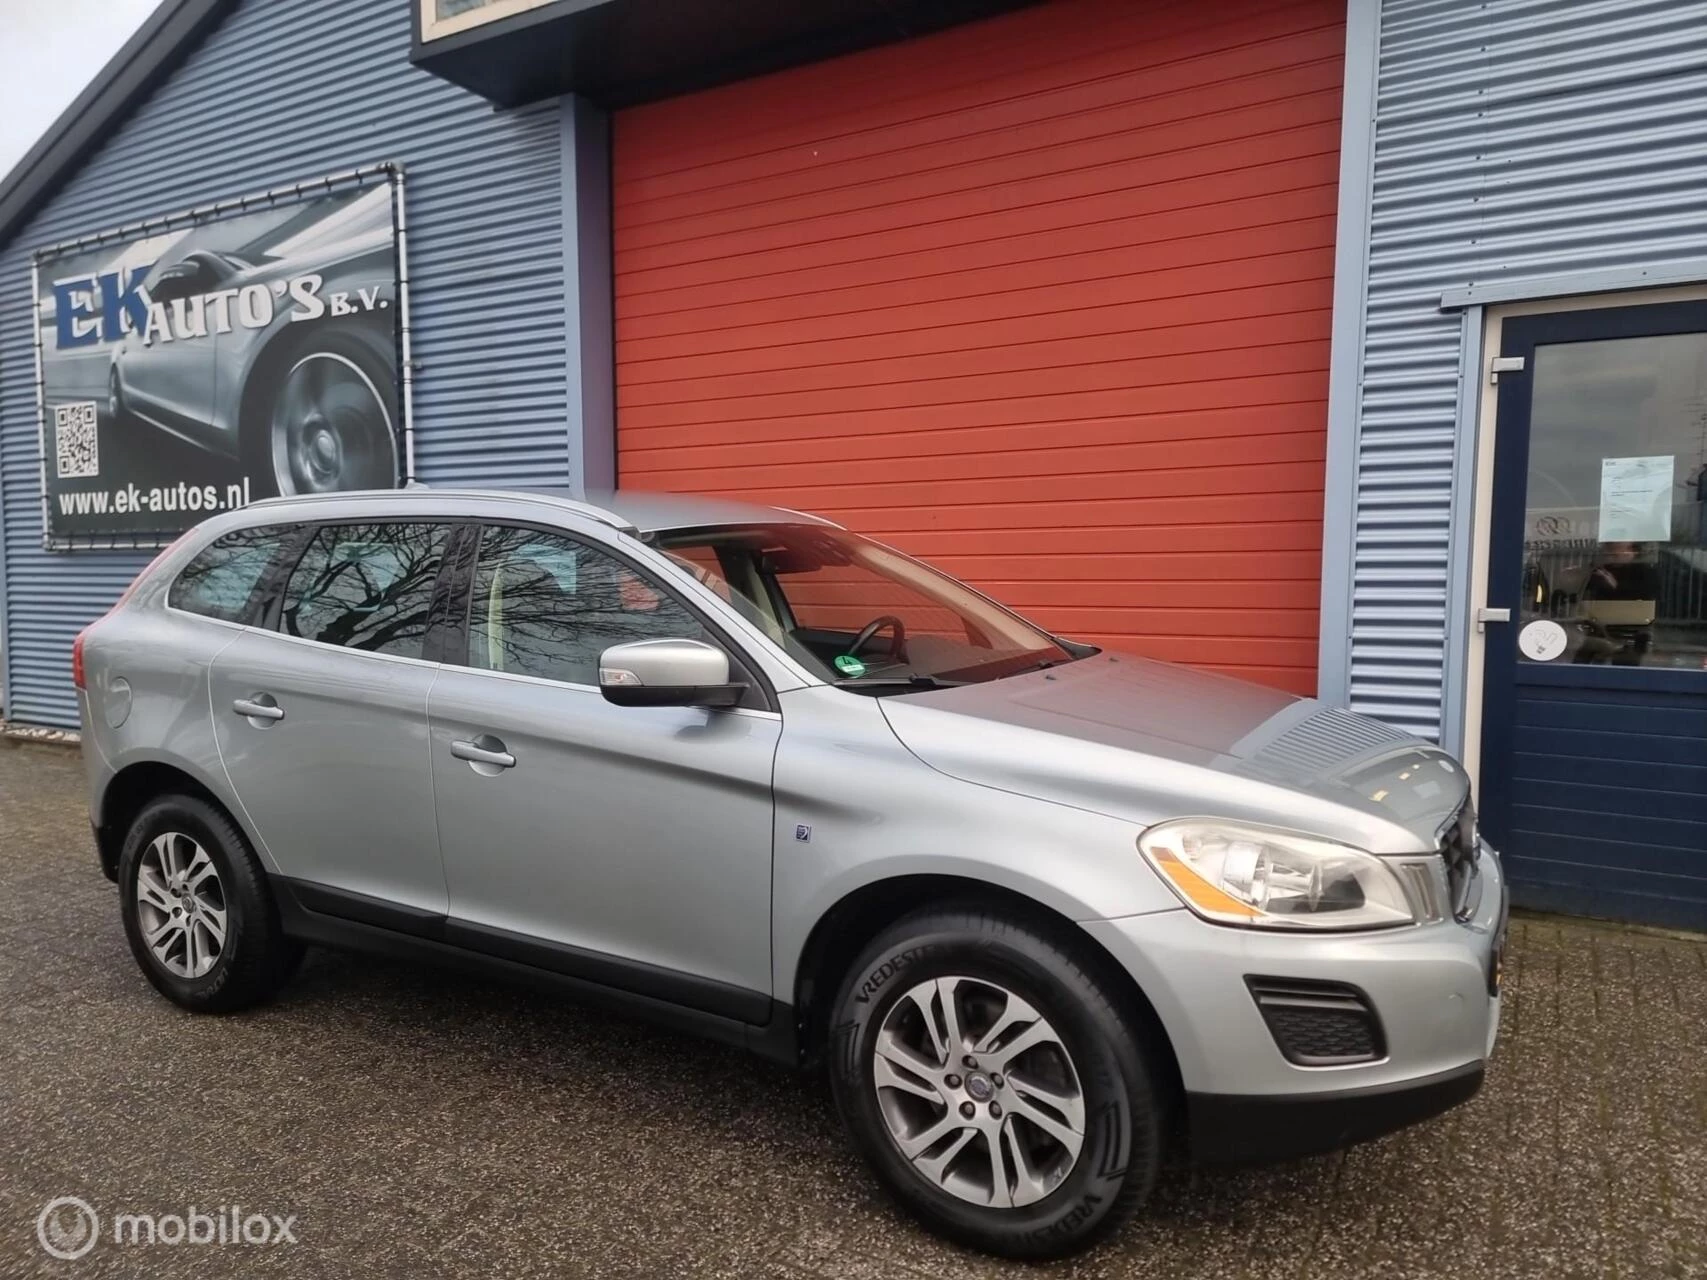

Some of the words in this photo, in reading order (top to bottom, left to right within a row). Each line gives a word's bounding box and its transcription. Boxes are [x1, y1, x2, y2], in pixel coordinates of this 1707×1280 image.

[53, 264, 152, 350] EK
[143, 274, 325, 345] AUTO'S
[330, 286, 389, 317] B.V.
[59, 477, 250, 515] www.ek-autos.nl
